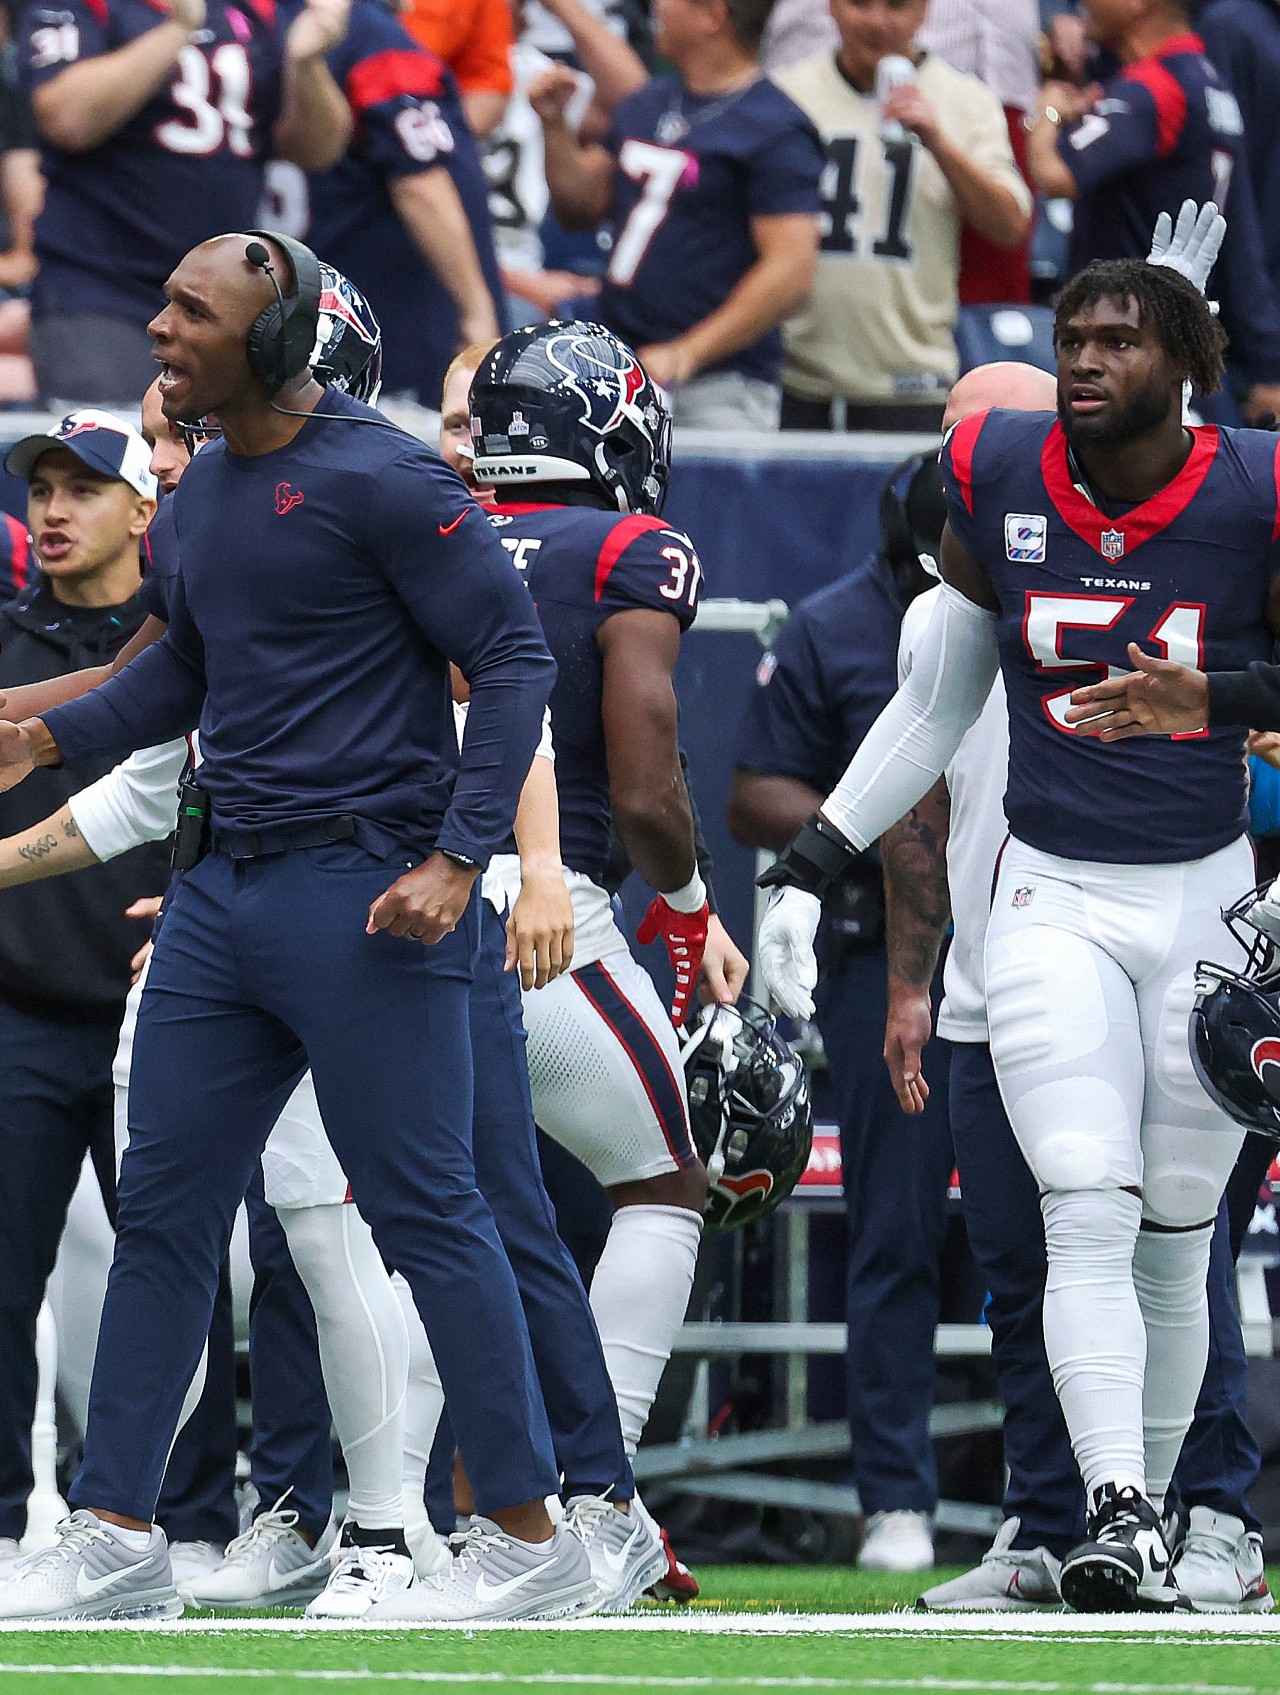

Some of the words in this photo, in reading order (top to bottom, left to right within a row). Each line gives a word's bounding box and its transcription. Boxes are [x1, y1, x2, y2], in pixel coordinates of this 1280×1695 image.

[609, 136, 691, 288] 7
[658, 545, 701, 607] 31
[1080, 577, 1151, 591] TEXANS
[669, 933, 691, 1018] JORDAN
